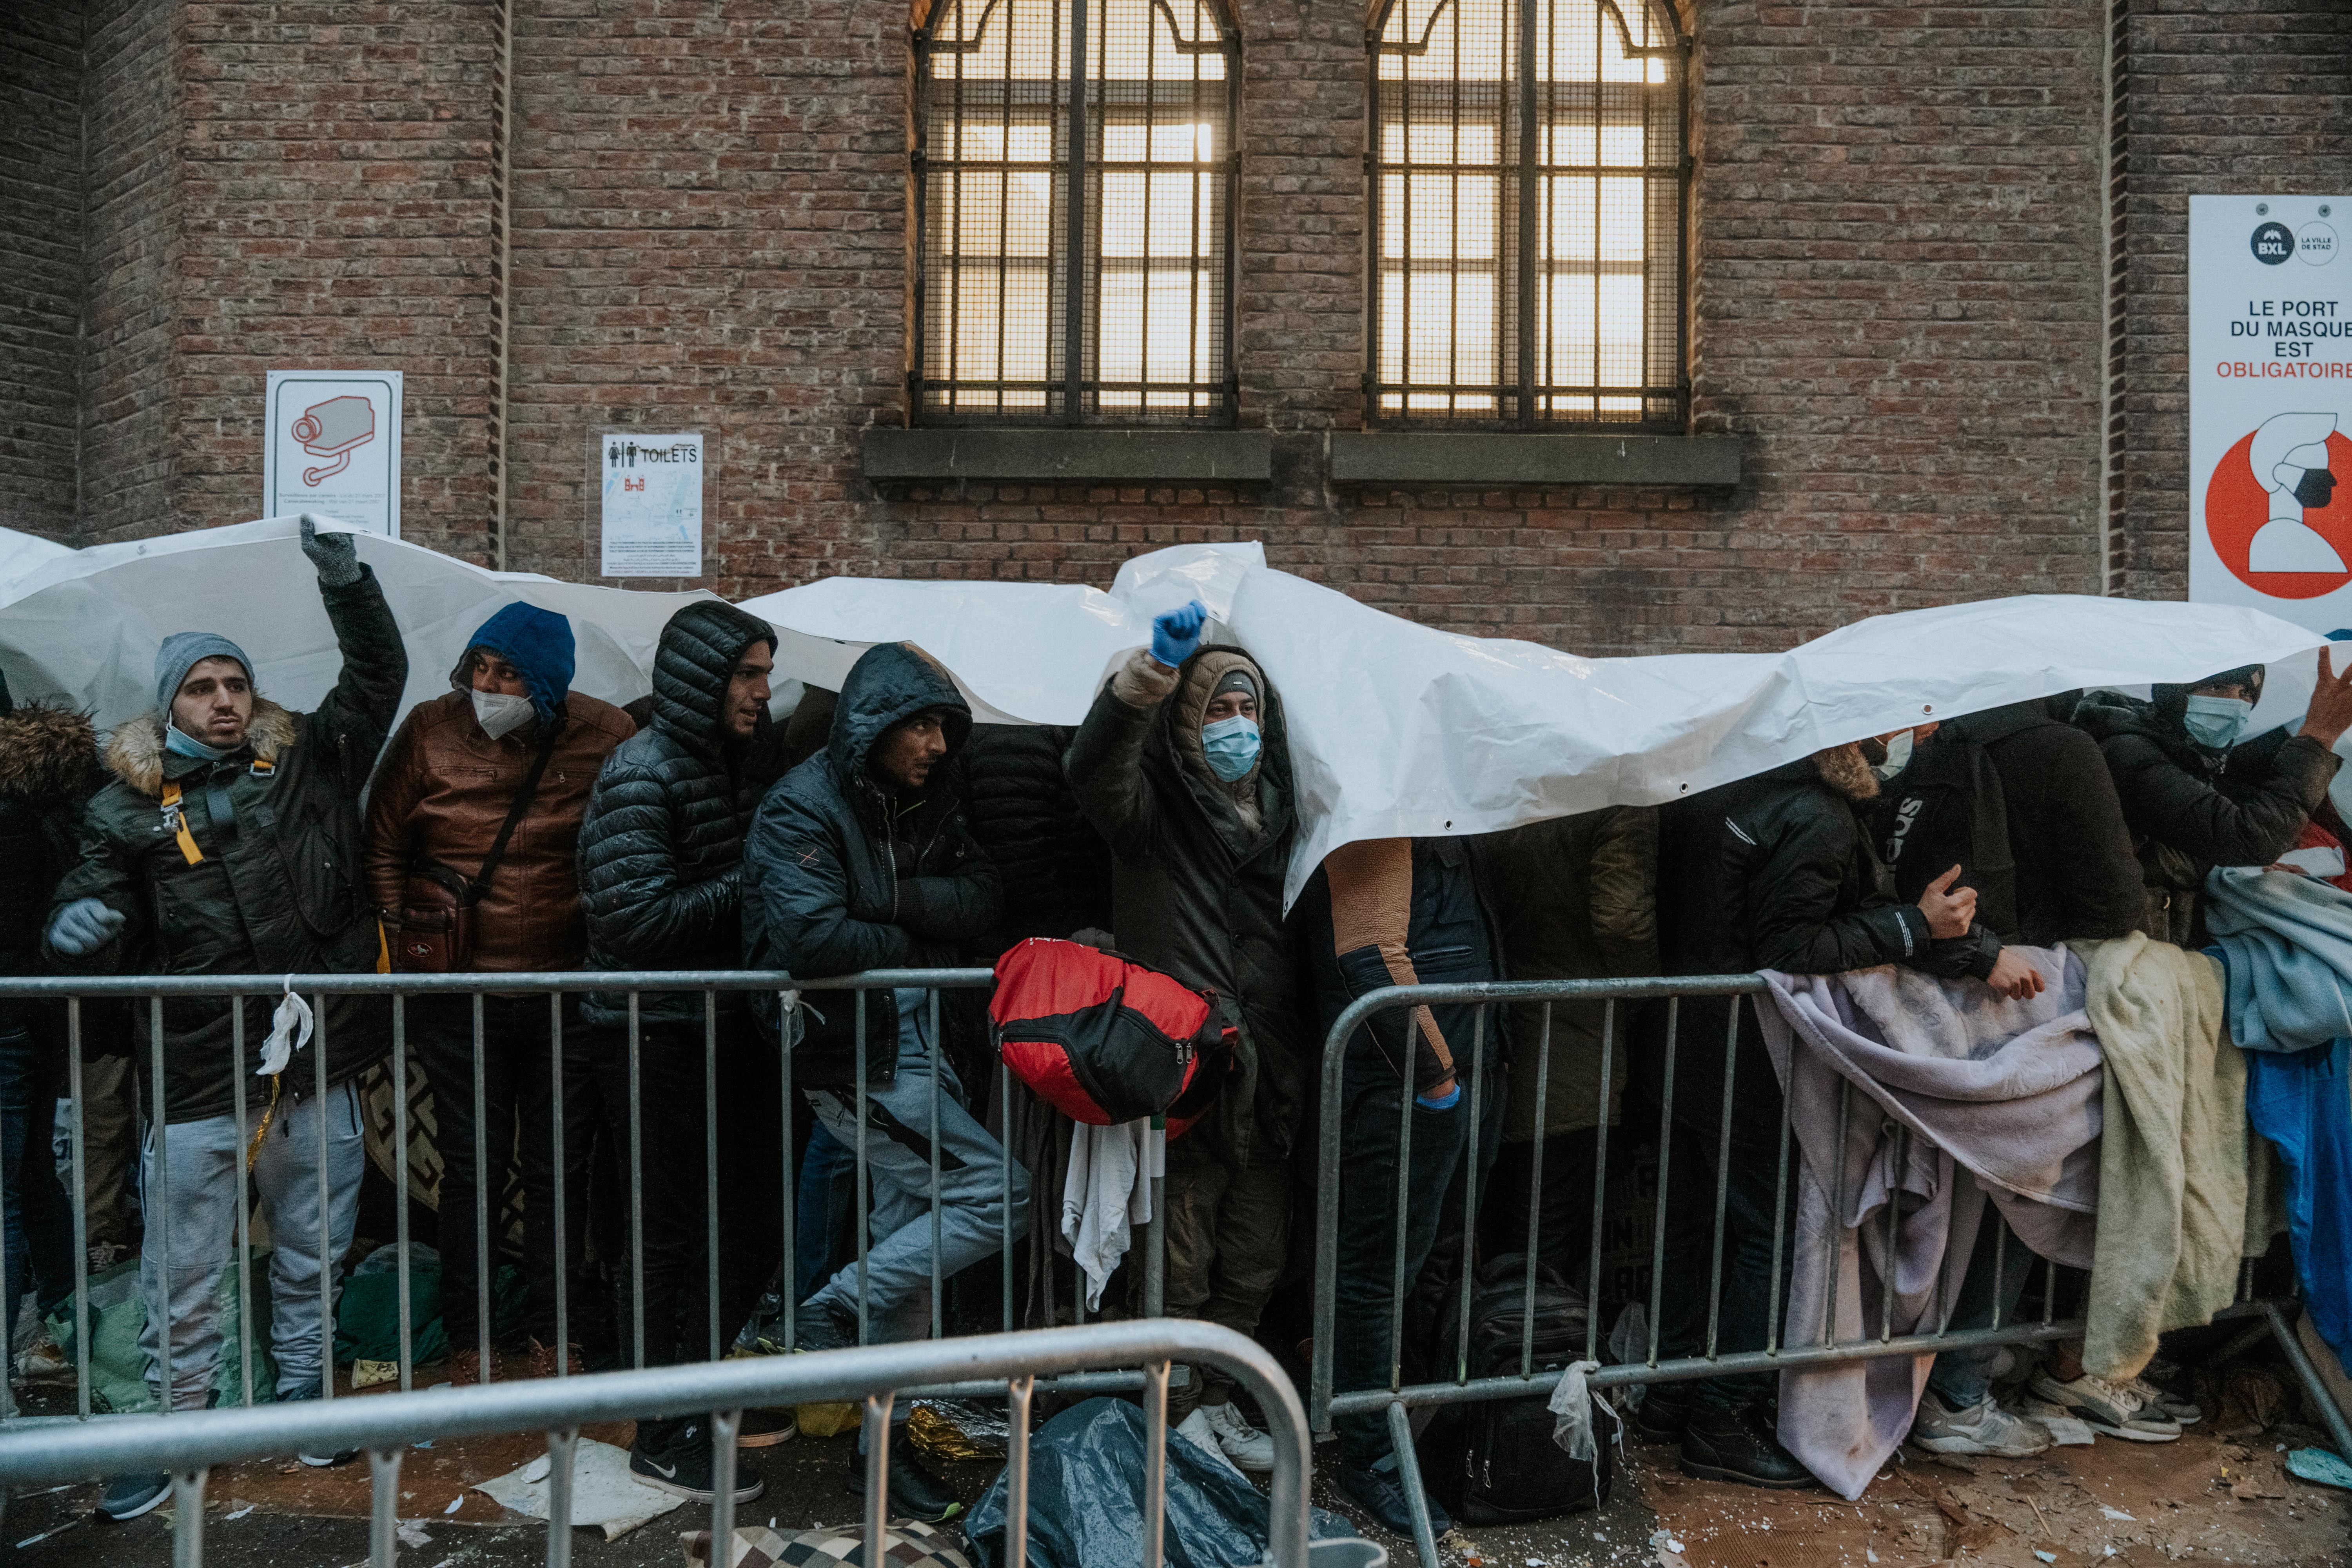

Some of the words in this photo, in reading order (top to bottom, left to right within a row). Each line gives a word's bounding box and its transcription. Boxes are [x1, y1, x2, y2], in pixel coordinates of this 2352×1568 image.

[2258, 243, 2287, 254] BXL
[2250, 301, 2274, 316] LE
[2282, 301, 2338, 316] PORT
[2231, 321, 2259, 336] DU
[2267, 321, 2352, 338] MASQUE
[2275, 342, 2314, 357] EST
[2217, 362, 2352, 378] OBLIGATOIRE
[641, 448, 697, 463] TOILETS
